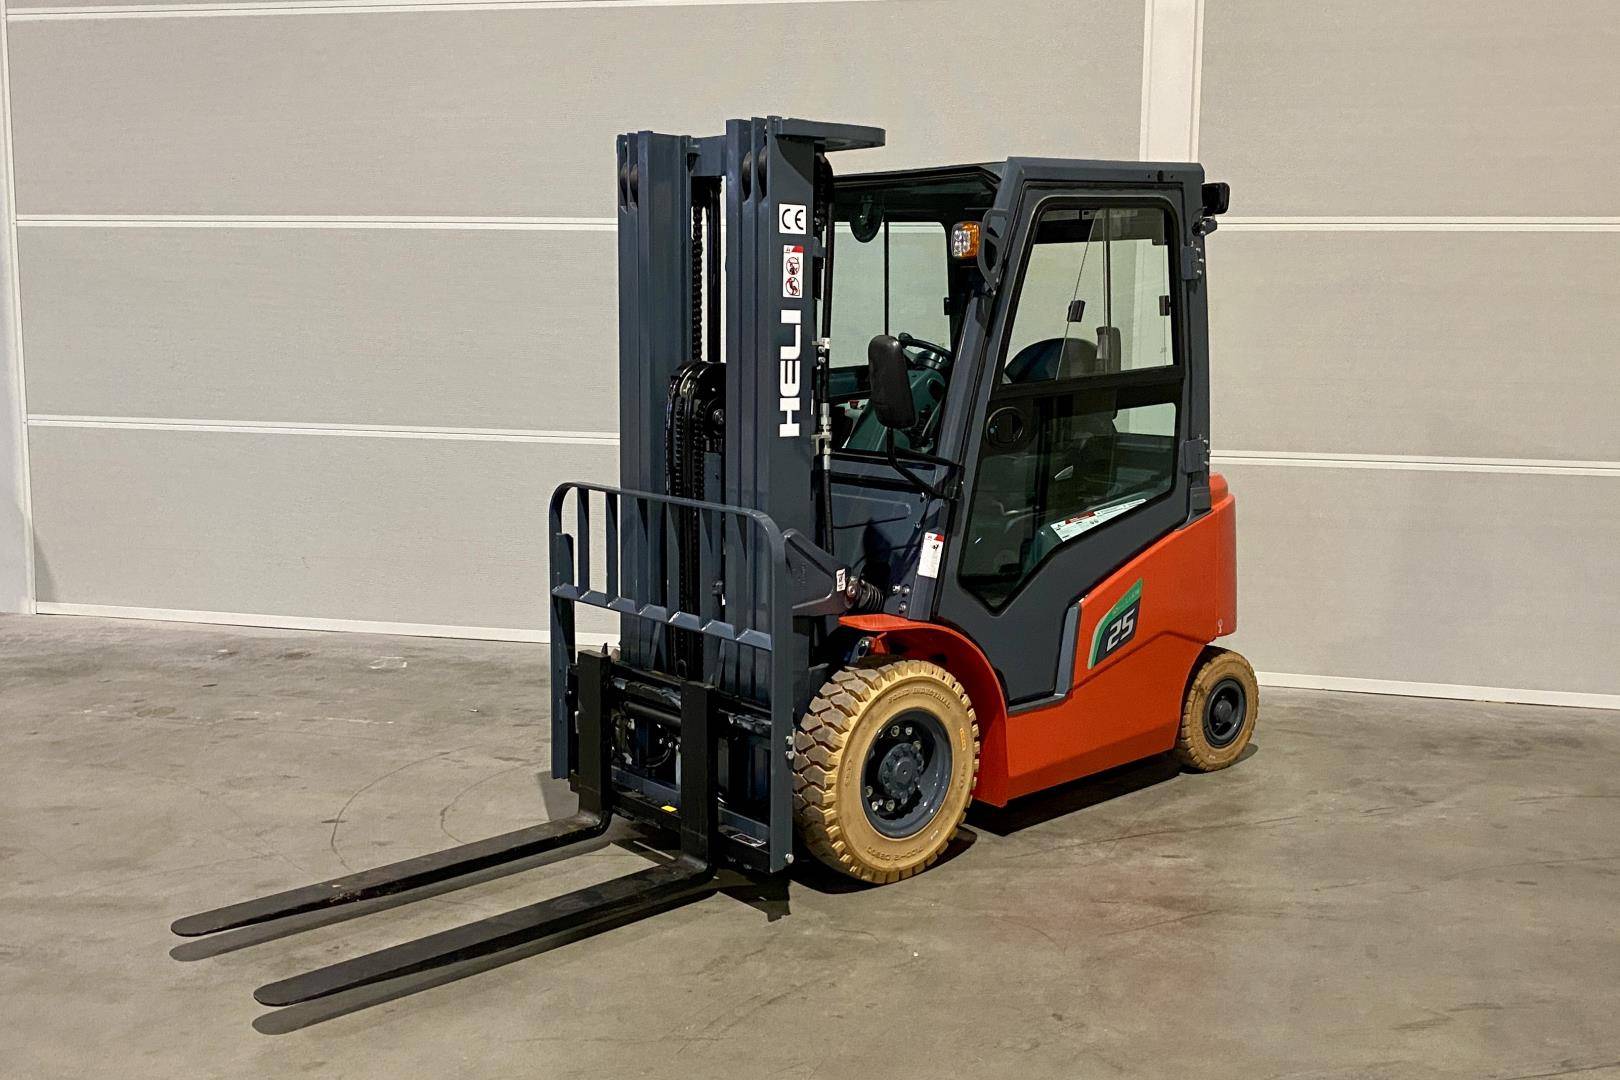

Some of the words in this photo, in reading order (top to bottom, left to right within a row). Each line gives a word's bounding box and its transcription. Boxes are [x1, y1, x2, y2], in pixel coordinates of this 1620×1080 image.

[782, 208, 804, 230] CE
[779, 309, 802, 437] HELI
[1106, 608, 1135, 651] 25
